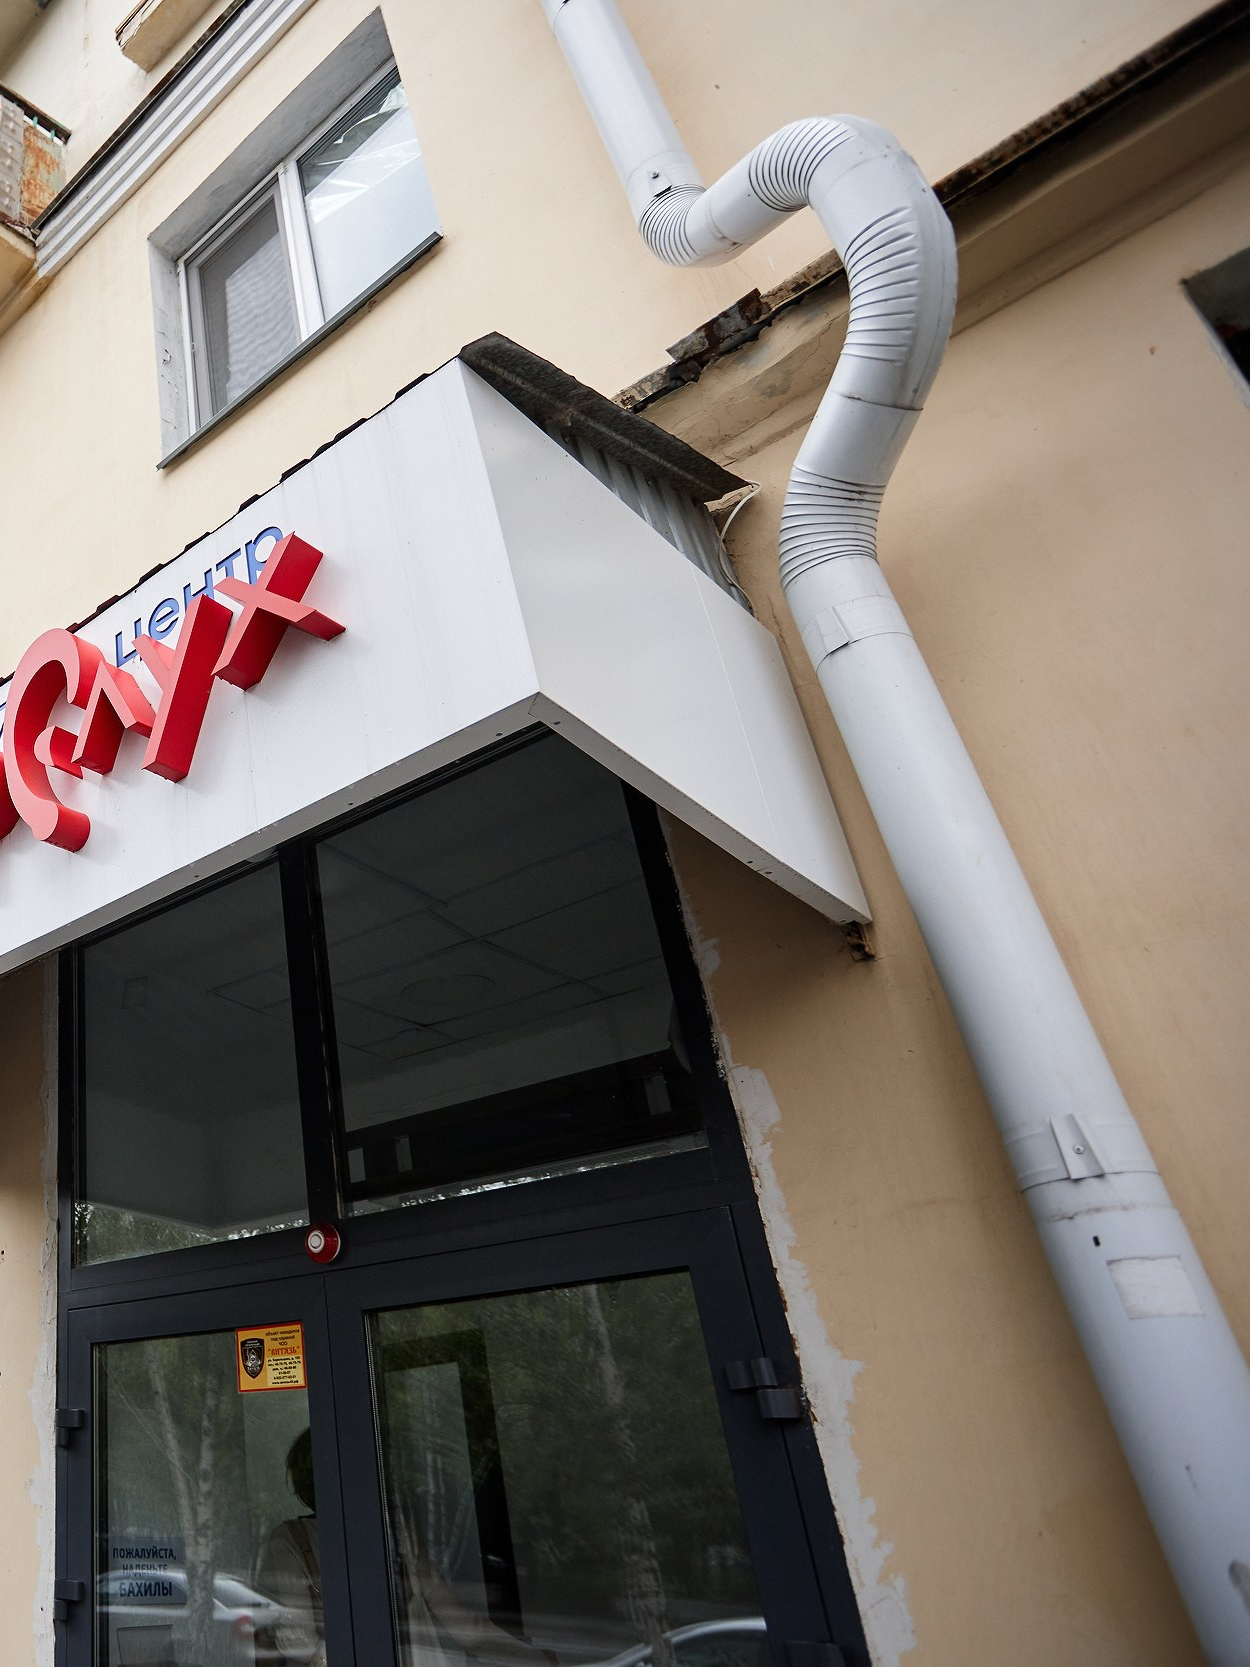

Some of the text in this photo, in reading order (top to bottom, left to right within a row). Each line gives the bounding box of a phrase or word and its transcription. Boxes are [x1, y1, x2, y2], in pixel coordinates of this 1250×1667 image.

[112, 1545, 177, 1561] ПОЖАЛУЙСТА,
[122, 1563, 168, 1577] НАДЕНЬТЕ
[119, 1581, 173, 1598] БАХИЛЫ
